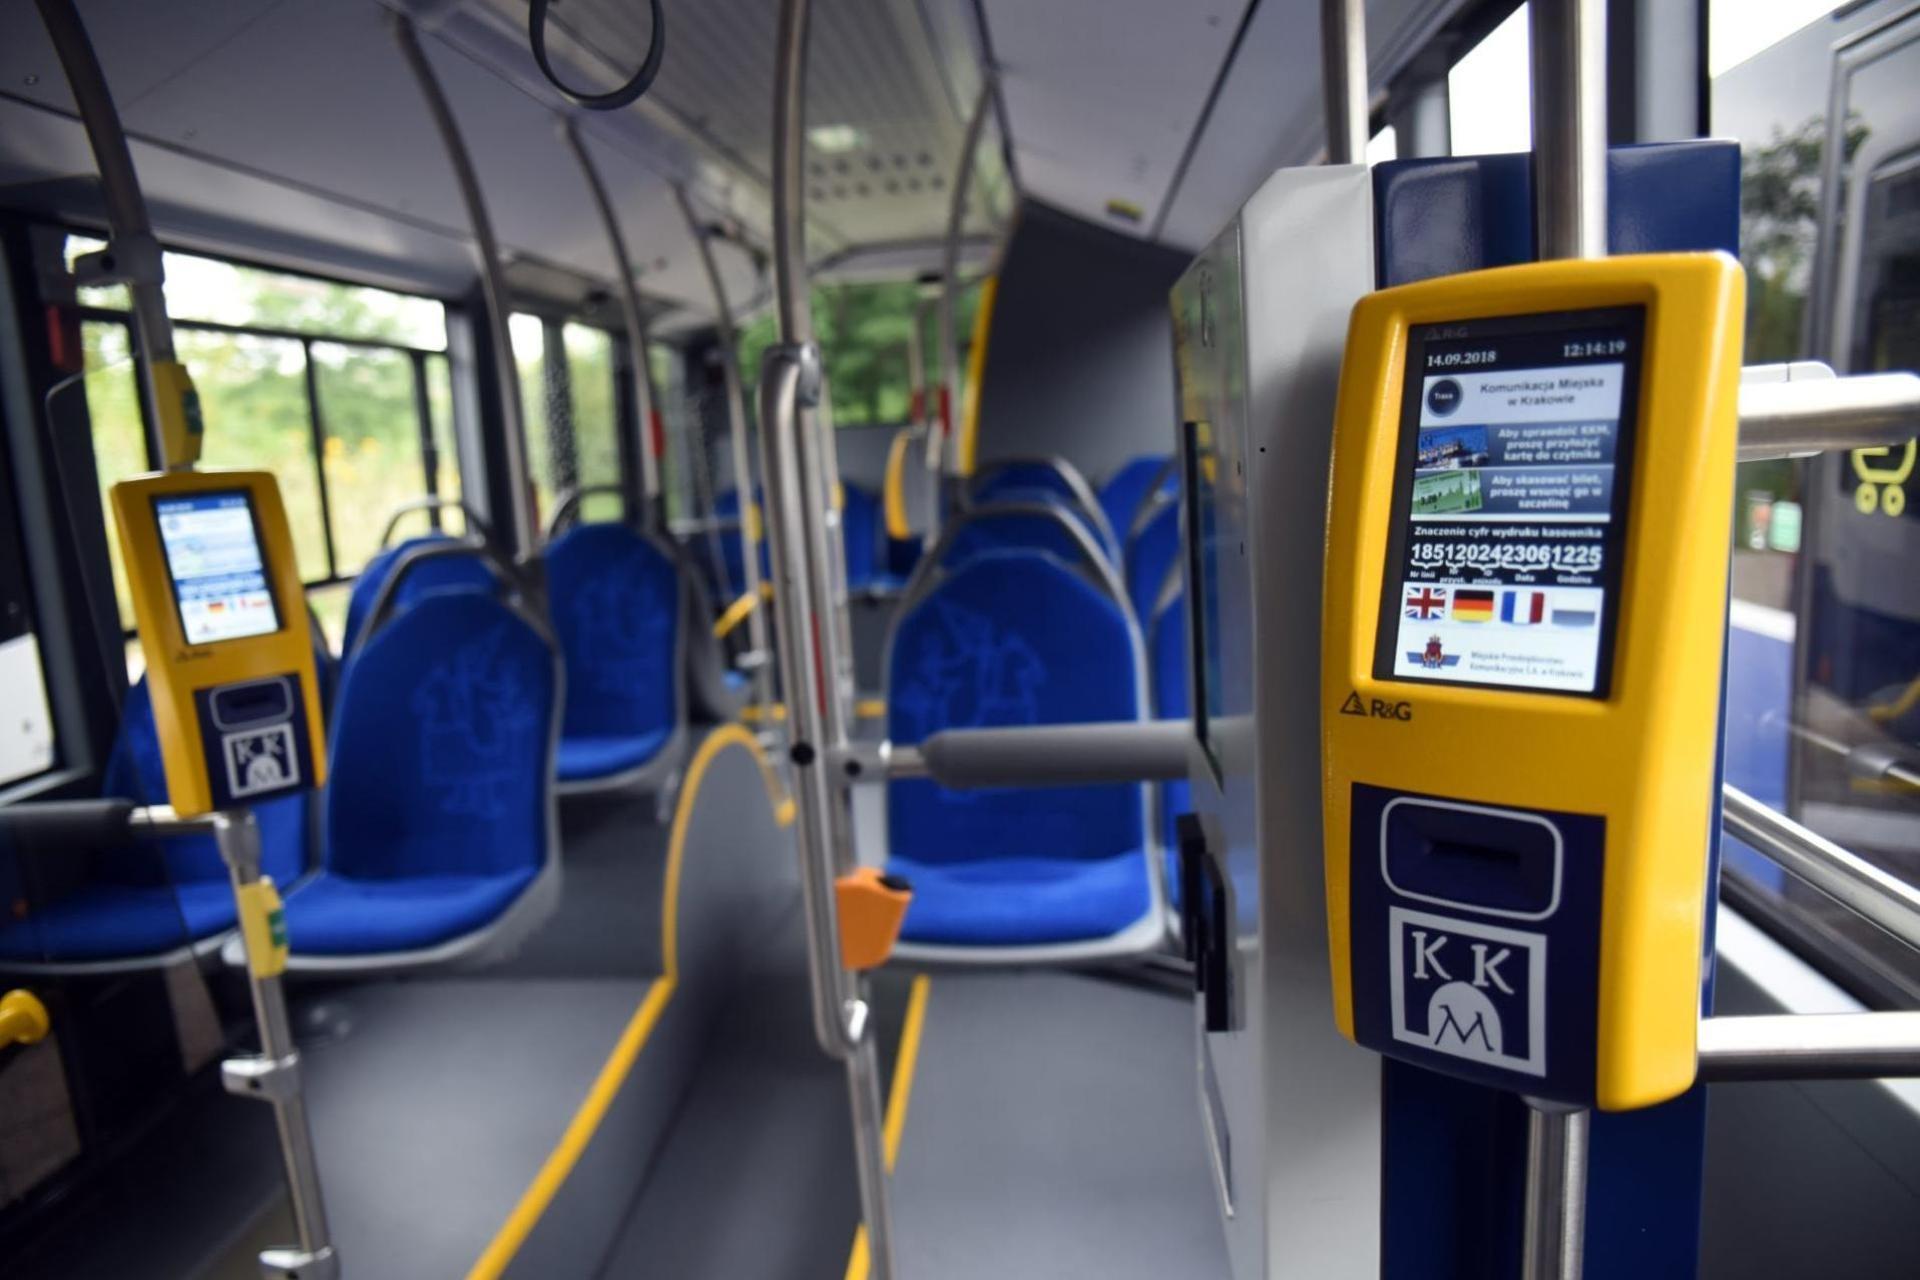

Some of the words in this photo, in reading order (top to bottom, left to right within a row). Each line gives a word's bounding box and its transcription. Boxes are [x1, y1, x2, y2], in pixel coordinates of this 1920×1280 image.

[1427, 351, 1497, 367] 14.09.2018
[1563, 340, 1626, 357] 12:14:19
[1480, 382, 1555, 394] Komunikacja
[1558, 378, 1604, 391] Miejska
[1520, 395, 1575, 405] Krakowie
[1498, 428, 1519, 439] Aby
[1506, 441, 1543, 451] proszę
[1504, 450, 1533, 461] kartę
[1535, 450, 1550, 460] do
[1552, 449, 1602, 461] czytnika
[1491, 475, 1512, 486] Aby
[1489, 487, 1526, 499] proszę
[1573, 488, 1589, 499] go
[1414, 526, 1466, 537] Znaczenie
[1468, 527, 1489, 538] cyfr
[1491, 526, 1539, 539] wydruku
[1541, 526, 1603, 538] kasownika
[1371, 699, 1411, 721] R&G
